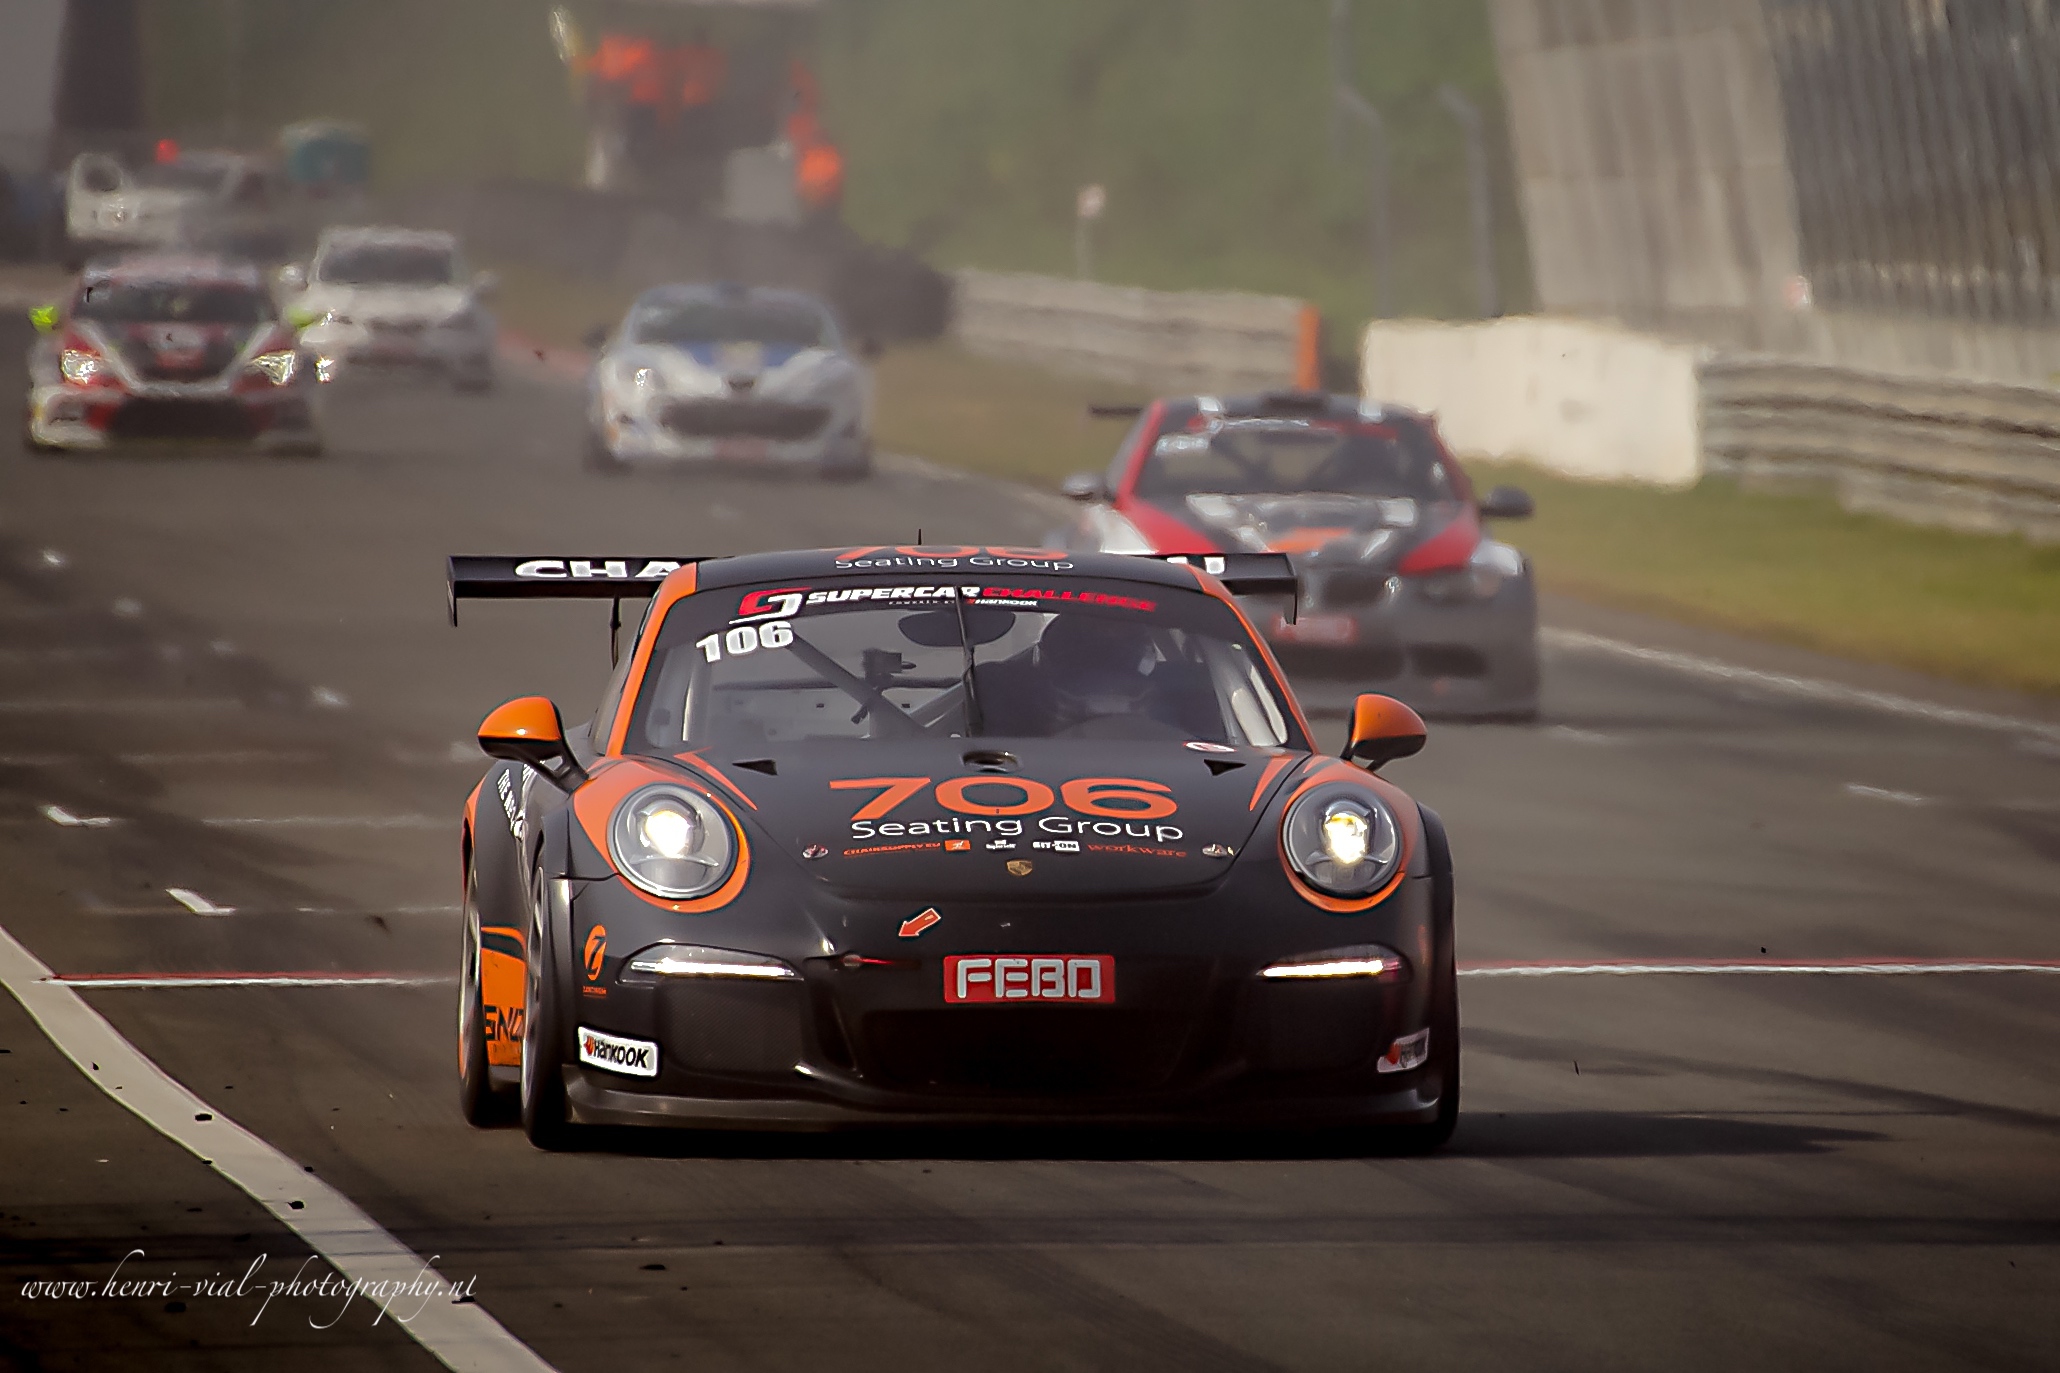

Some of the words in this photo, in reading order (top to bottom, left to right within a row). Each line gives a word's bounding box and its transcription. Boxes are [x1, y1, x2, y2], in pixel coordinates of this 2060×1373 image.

[969, 557, 1074, 570] Group
[806, 586, 980, 605] SUPERCAR
[982, 586, 1157, 611] CHALLENGE
[696, 621, 794, 663] 106
[829, 776, 1179, 820] 706
[851, 817, 1024, 839] Seating
[1038, 817, 1184, 842] Group
[1087, 843, 1188, 858] workware
[957, 958, 1101, 999] FEBO
